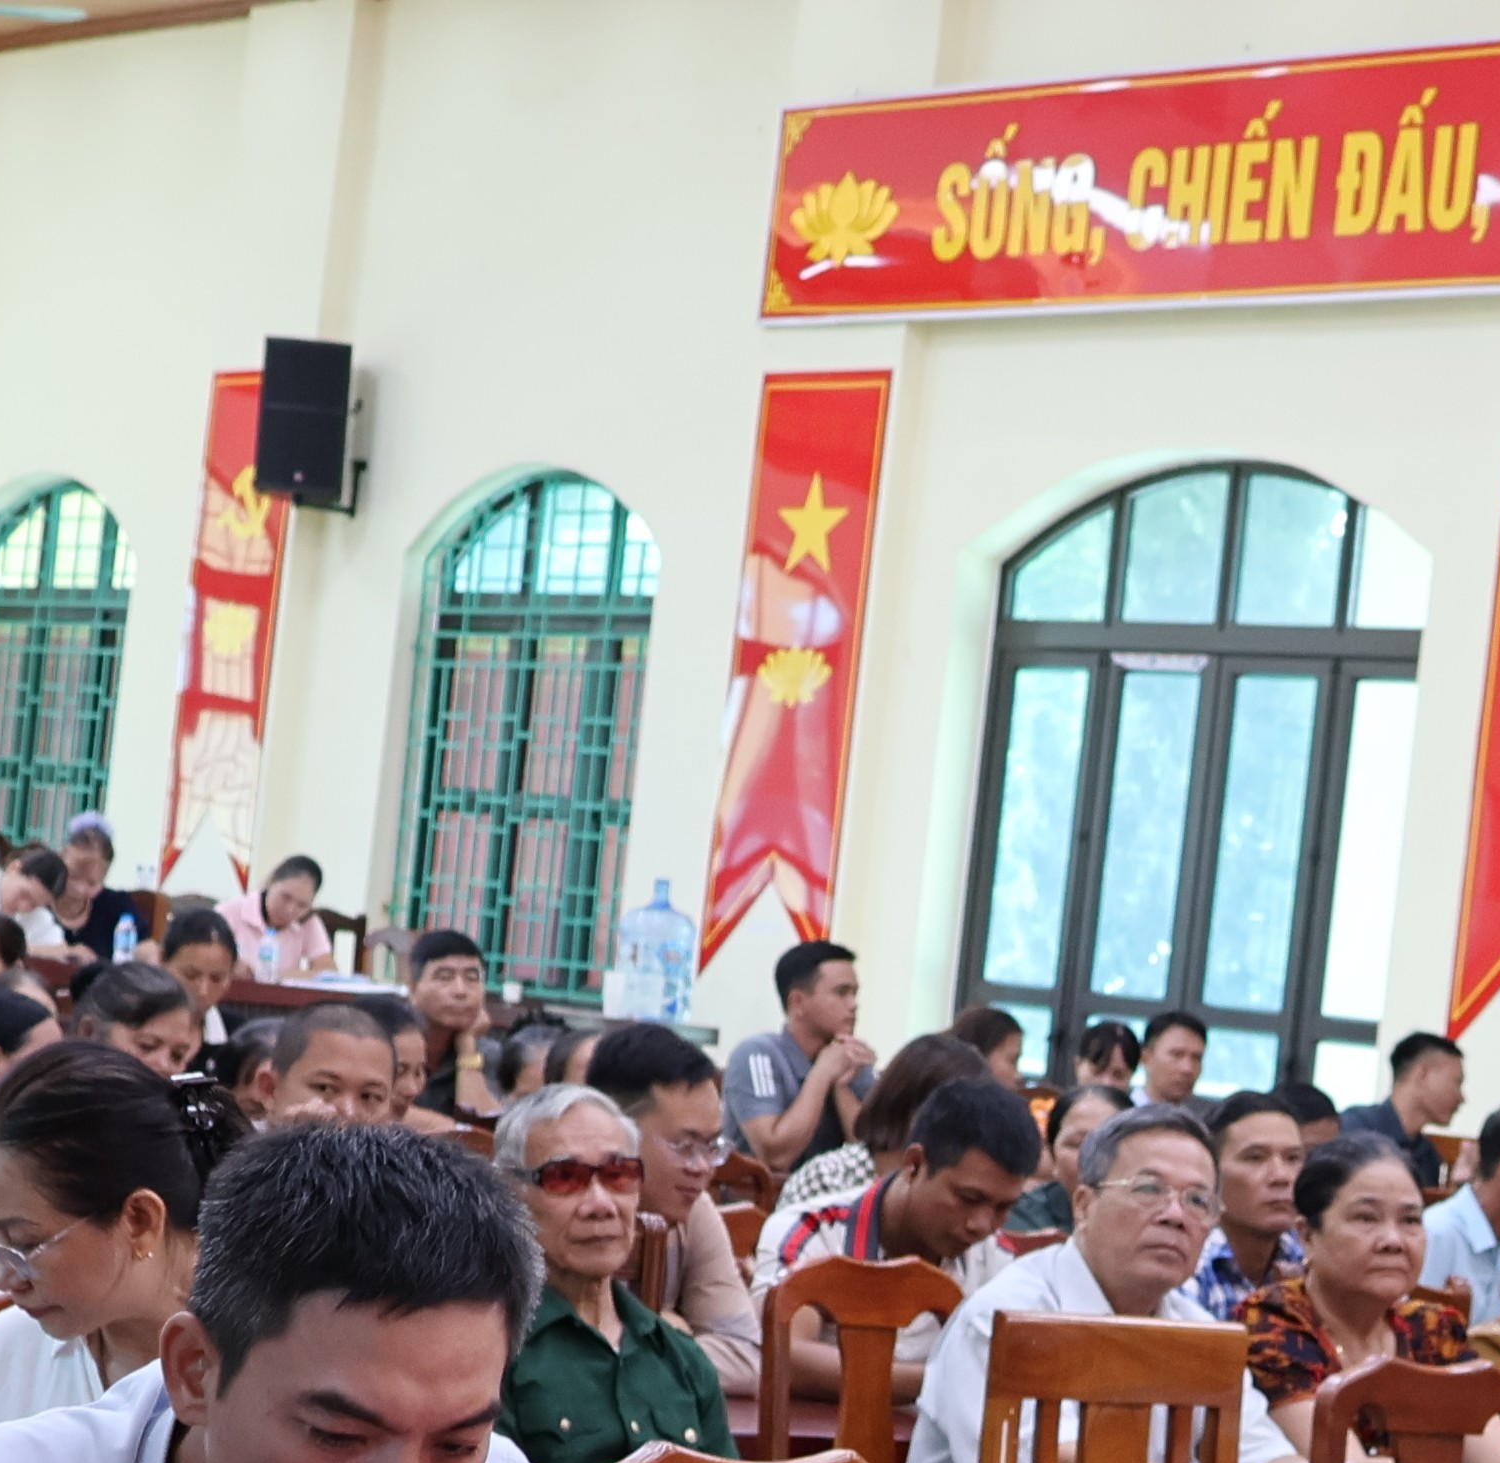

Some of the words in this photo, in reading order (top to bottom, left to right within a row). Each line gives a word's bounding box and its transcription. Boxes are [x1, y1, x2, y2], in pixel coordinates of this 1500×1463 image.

[931, 123, 1104, 265] SỐNG,
[1125, 99, 1318, 250] CHIẾN
[1332, 86, 1489, 242] ĐẤU,
